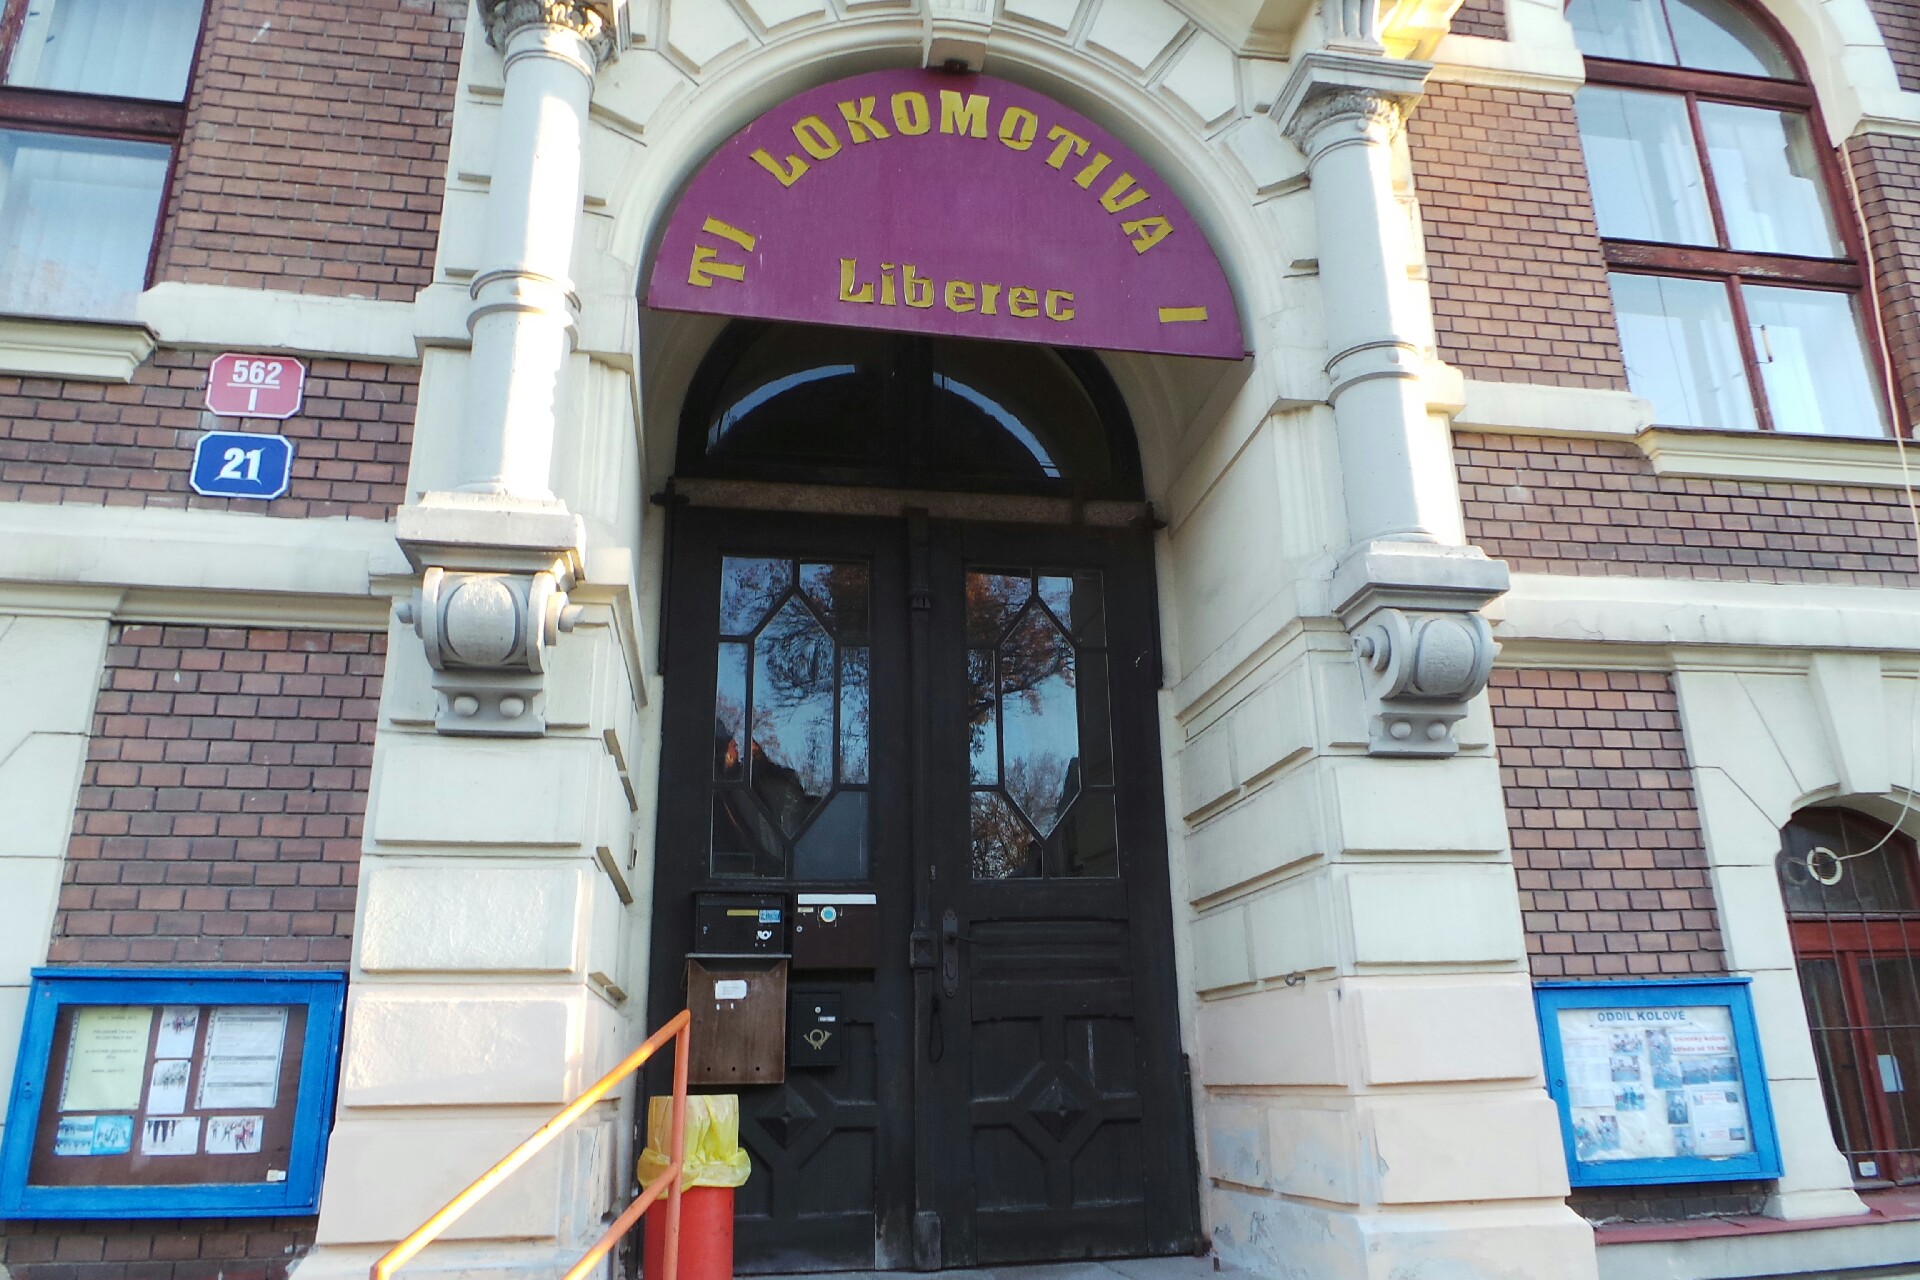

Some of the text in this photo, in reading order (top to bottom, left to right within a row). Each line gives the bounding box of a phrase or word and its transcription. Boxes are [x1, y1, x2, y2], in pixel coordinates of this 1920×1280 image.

[749, 89, 1174, 256] LOKOMOTIVA
[839, 257, 1075, 322] Liberec
[233, 360, 282, 385] 562
[214, 446, 266, 485] 21
